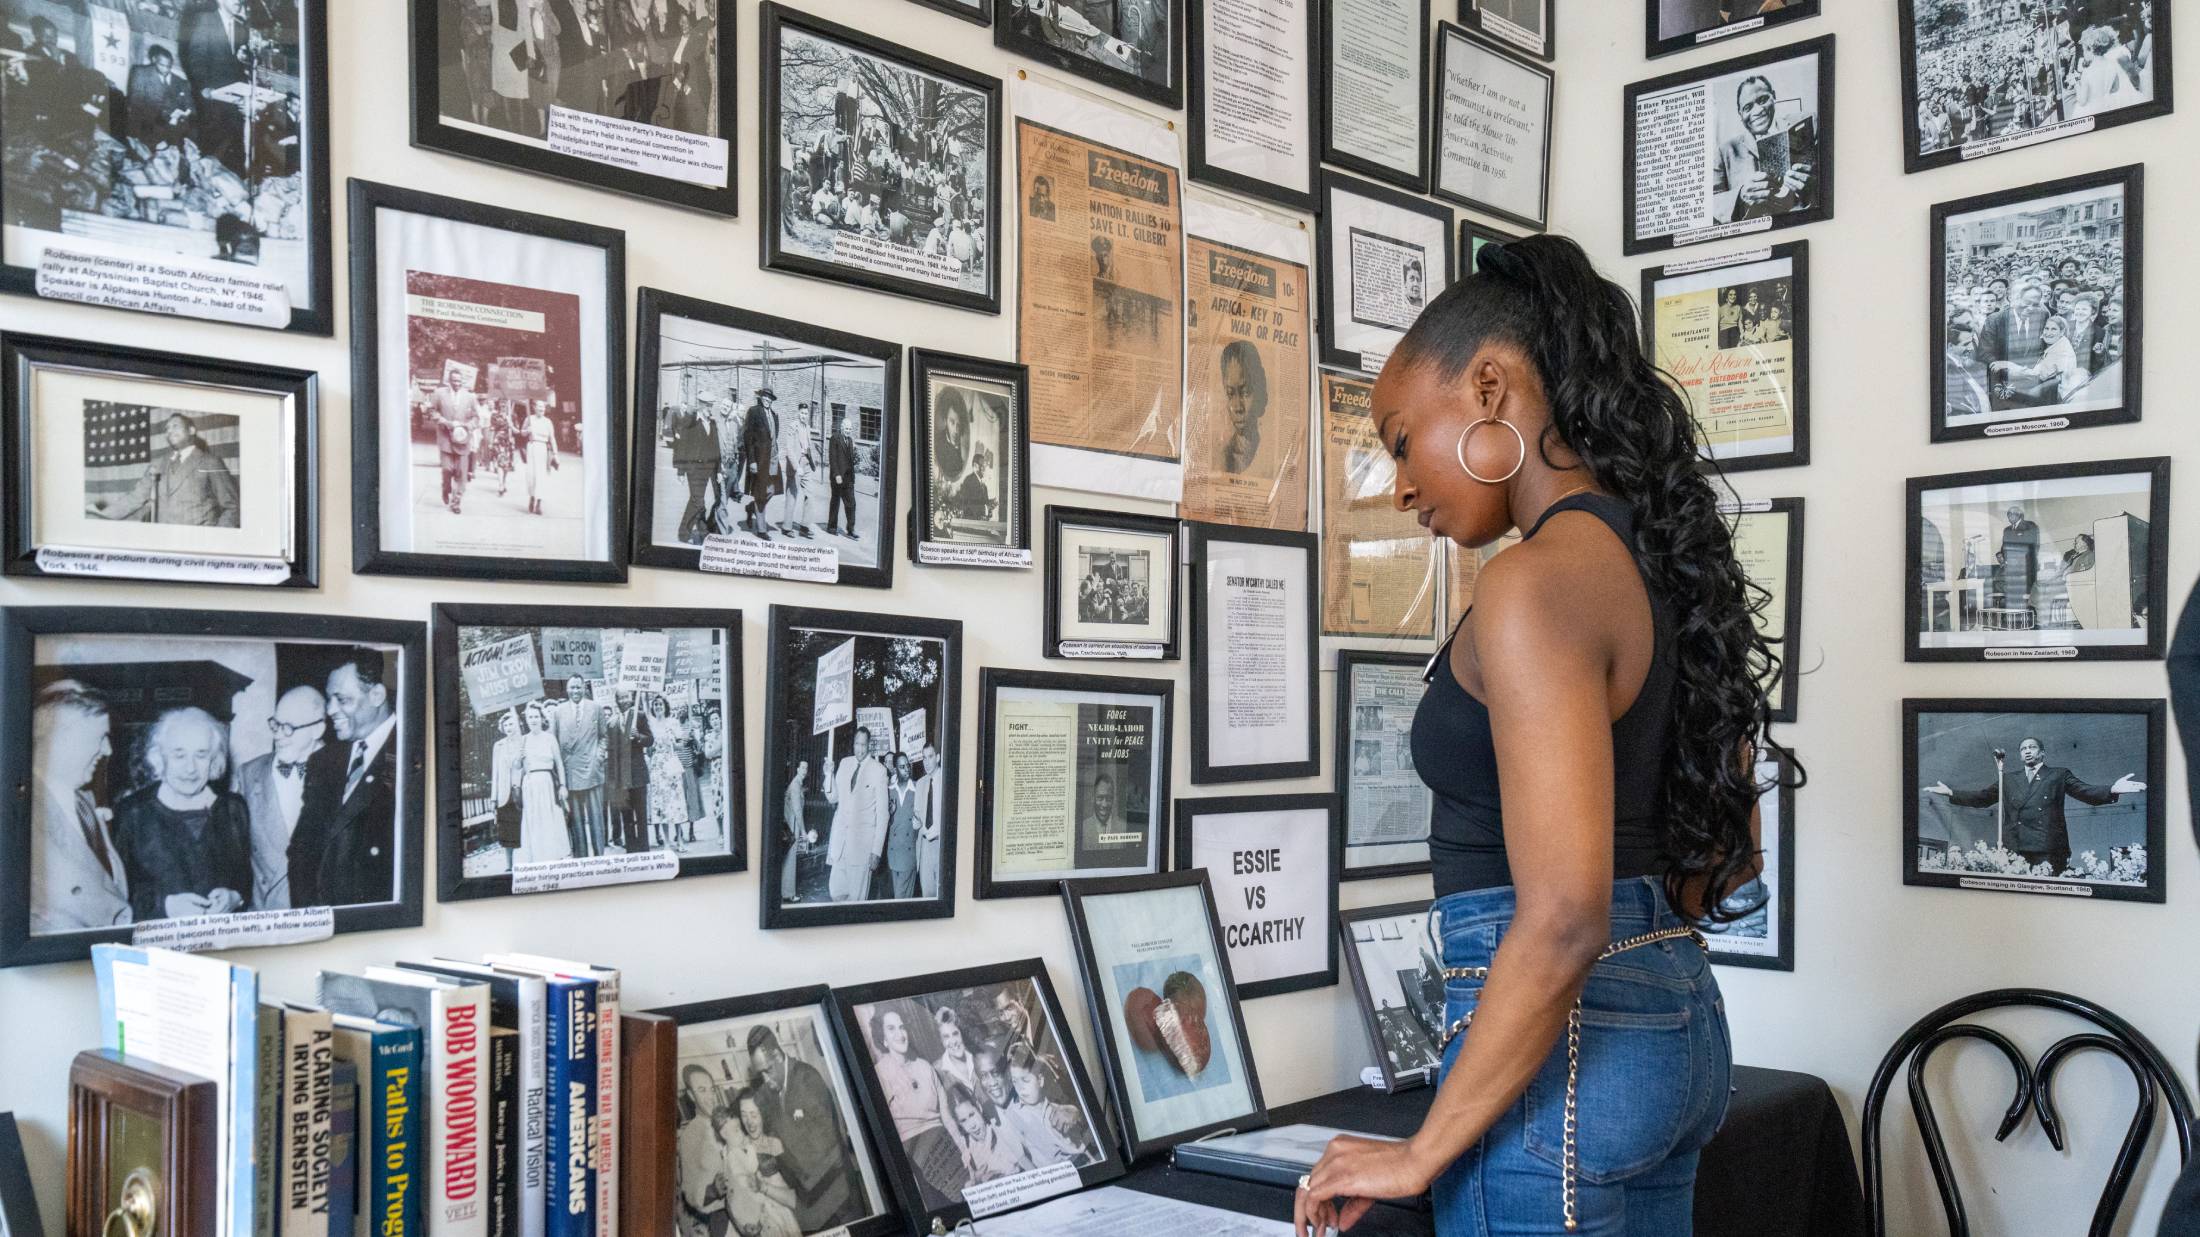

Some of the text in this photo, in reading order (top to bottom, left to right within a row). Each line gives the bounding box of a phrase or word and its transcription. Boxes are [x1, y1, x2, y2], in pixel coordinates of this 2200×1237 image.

[1445, 88, 1485, 114] Communist
[1482, 84, 1486, 95] I
[1487, 89, 1498, 98] am
[1500, 94, 1507, 102] or
[1509, 97, 1521, 109] not
[1521, 103, 1526, 112] a
[568, 112, 581, 121] with
[583, 115, 593, 123] the
[595, 118, 631, 132] Progressive
[633, 125, 653, 137] Party's
[656, 129, 673, 140] Peace
[675, 134, 710, 148] Delegation,
[1454, 113, 1467, 126] told
[1469, 118, 1480, 132] the
[1505, 133, 1519, 145] Un-
[1961, 142, 1987, 152] Robeson
[1989, 137, 2009, 147] speaks
[2011, 131, 2033, 142] against
[2034, 126, 2057, 136] nuclear
[2059, 119, 2086, 131] weapons
[1093, 157, 1160, 193] Freedom
[1090, 200, 1171, 231] NATION RALLIES TO
[1090, 217, 1113, 234] SAVE
[1133, 227, 1167, 246] GILBERT
[44, 248, 284, 292] Robeson (center) at a South African famine relief
[1213, 257, 1269, 287] Freedom
[1251, 305, 1268, 322] KEY
[1273, 311, 1283, 326] TO
[1231, 319, 1298, 347] WAR OR PEACE
[1332, 386, 1371, 408] Freedo
[551, 640, 596, 652] JIM CROW
[551, 654, 592, 666] MUST GO
[478, 656, 532, 682] JIM CROW
[479, 673, 528, 698] MUST GO
[1088, 723, 1144, 732] NEGRO-LABOR
[1106, 710, 1127, 720] FORGE
[1087, 736, 1144, 745] UNITY for PEACE
[1101, 749, 1129, 759] and JOBS
[1232, 848, 1282, 875] ESSIE
[1244, 886, 1266, 910] VS
[574, 989, 585, 1060] SANTOLI
[586, 1012, 596, 1032] AL
[386, 1067, 409, 1139] Paths
[445, 1004, 477, 1200] BOB WOODWARD
[600, 1008, 612, 1174] THE COMING RACE WAR IN AMERICA
[292, 1044, 309, 1210] IRVING BERNSTEIN
[311, 1030, 332, 1214] A CARING SOCIETY
[526, 1087, 543, 1141] Radical
[386, 1142, 406, 1170] to
[569, 1080, 586, 1216] AMERICANS
[526, 1142, 543, 1188] Vision
